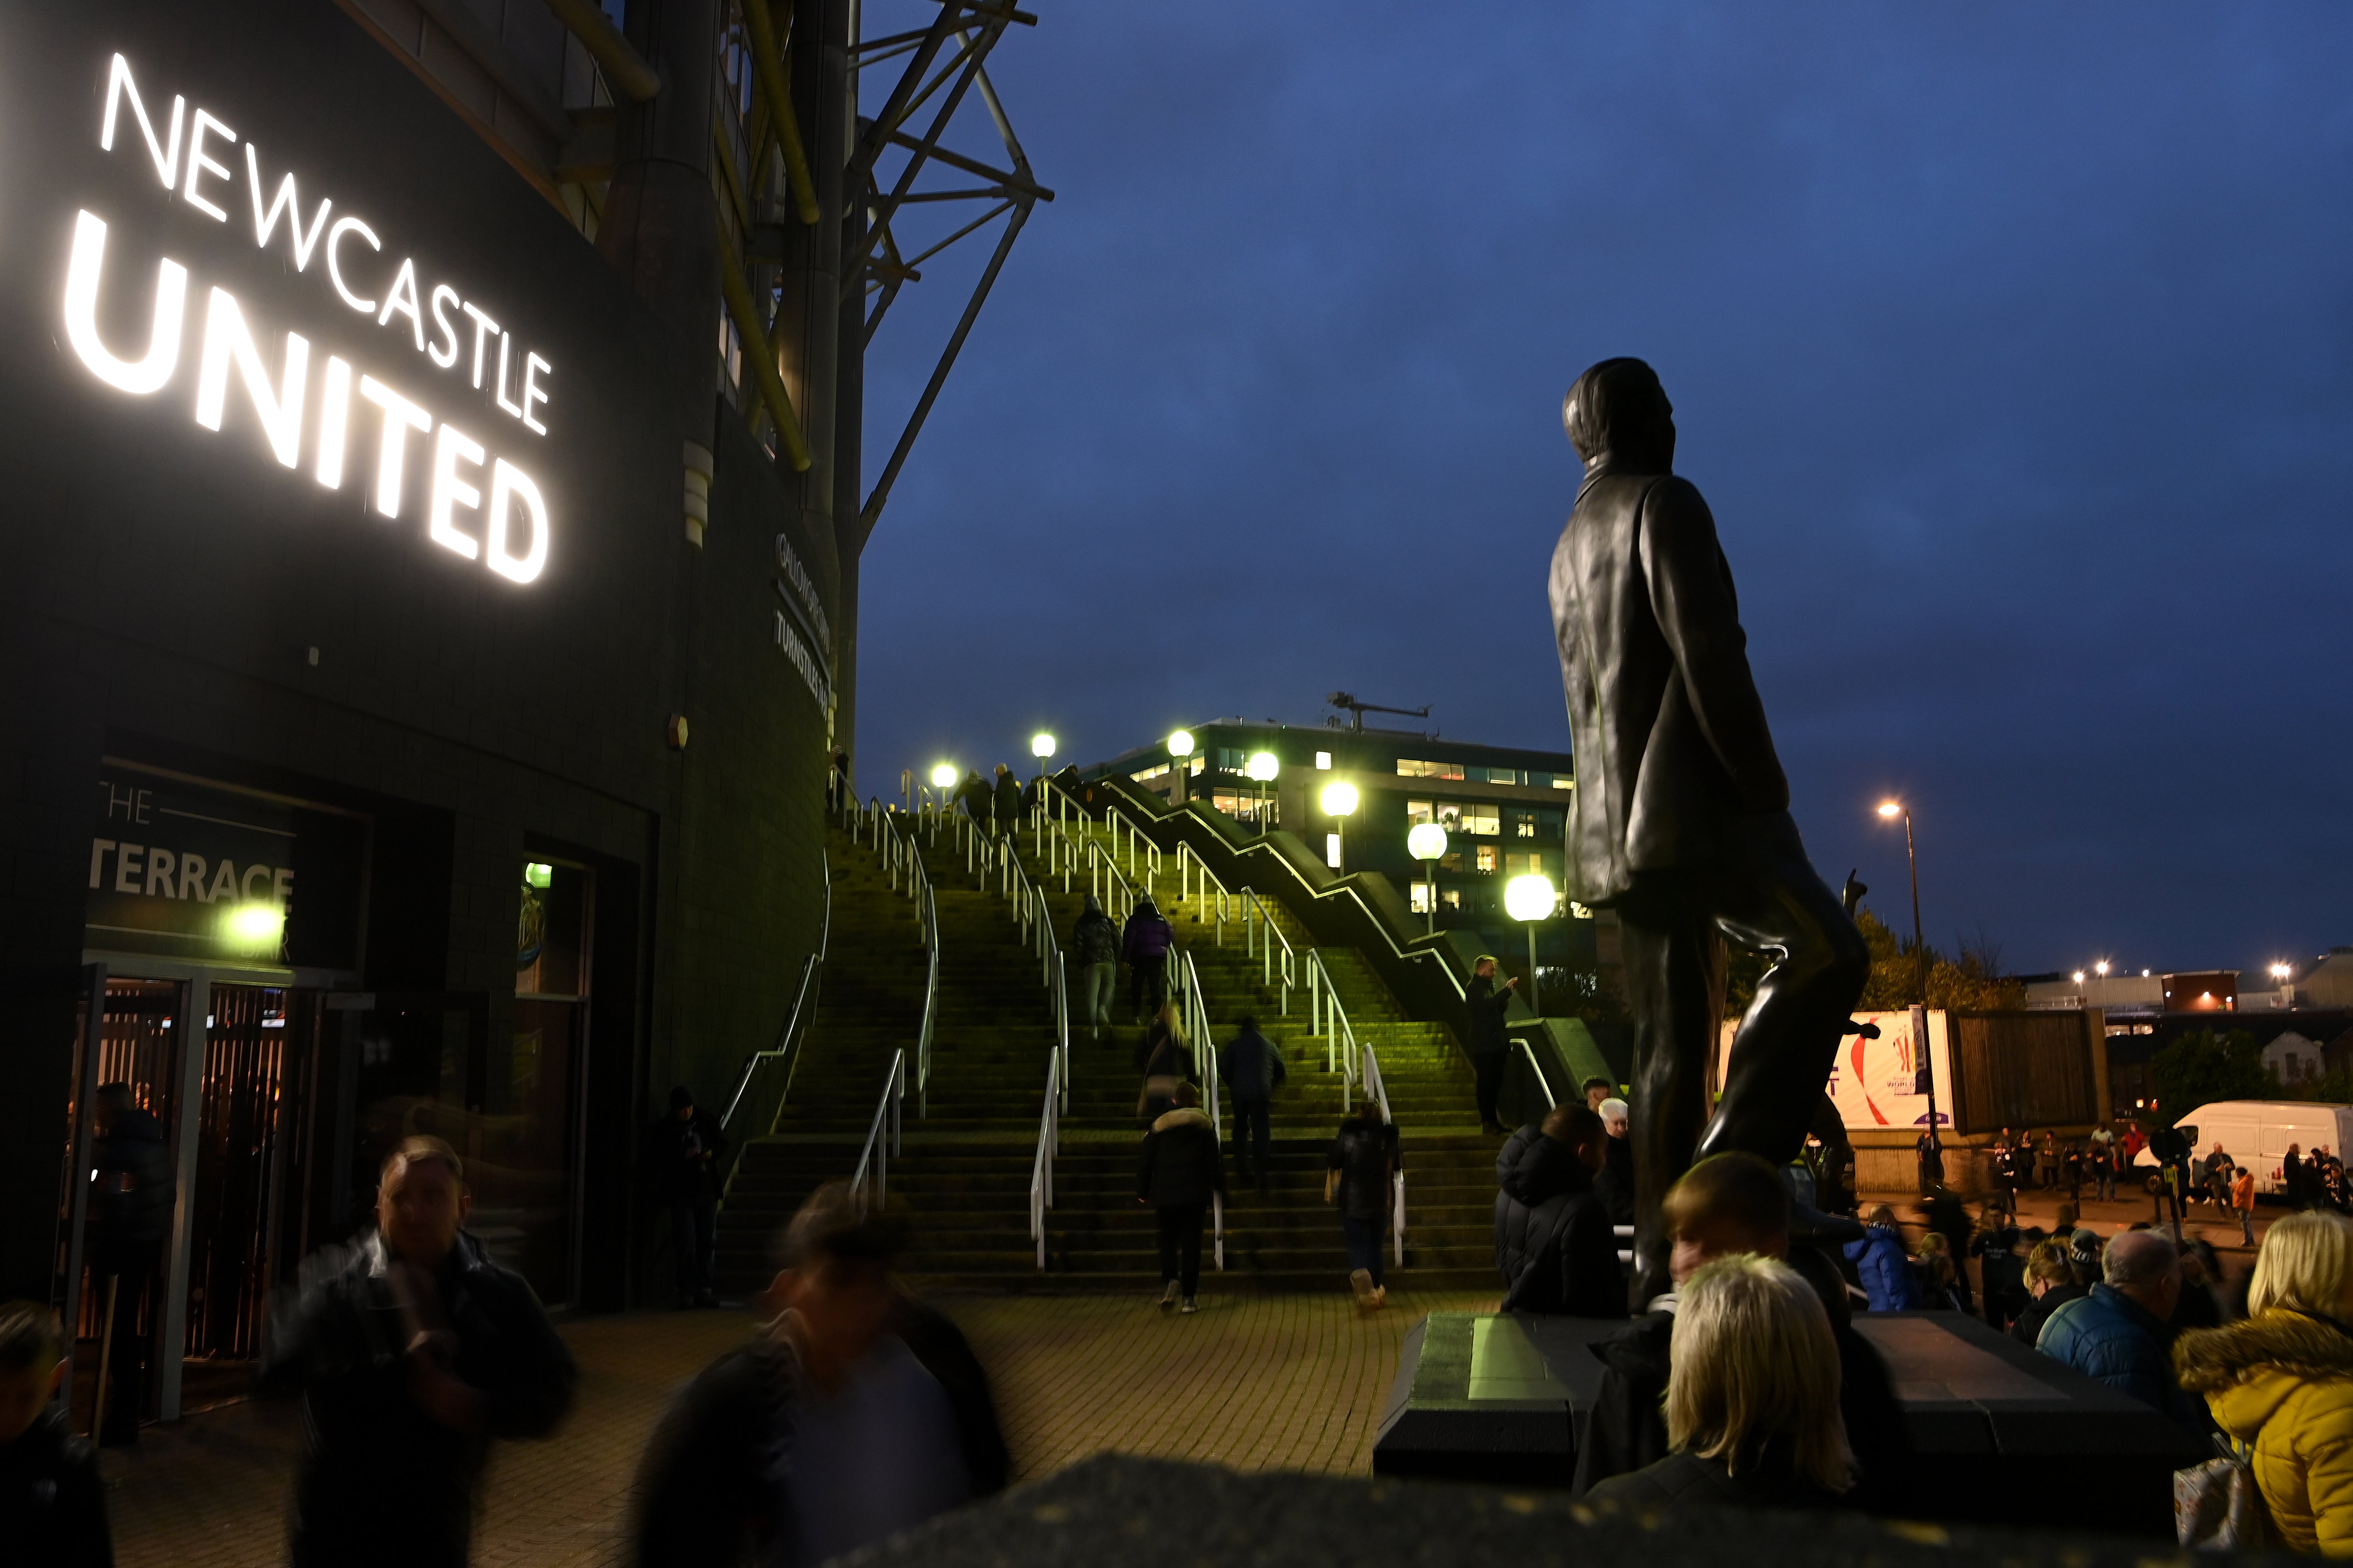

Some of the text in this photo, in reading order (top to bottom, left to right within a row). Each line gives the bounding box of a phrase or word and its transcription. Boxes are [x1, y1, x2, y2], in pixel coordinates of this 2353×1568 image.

[101, 52, 551, 436] NEWCASTLE
[64, 209, 548, 584] UNITED
[777, 609, 818, 699] TURNSTILES
[89, 837, 295, 914] TERRACE
